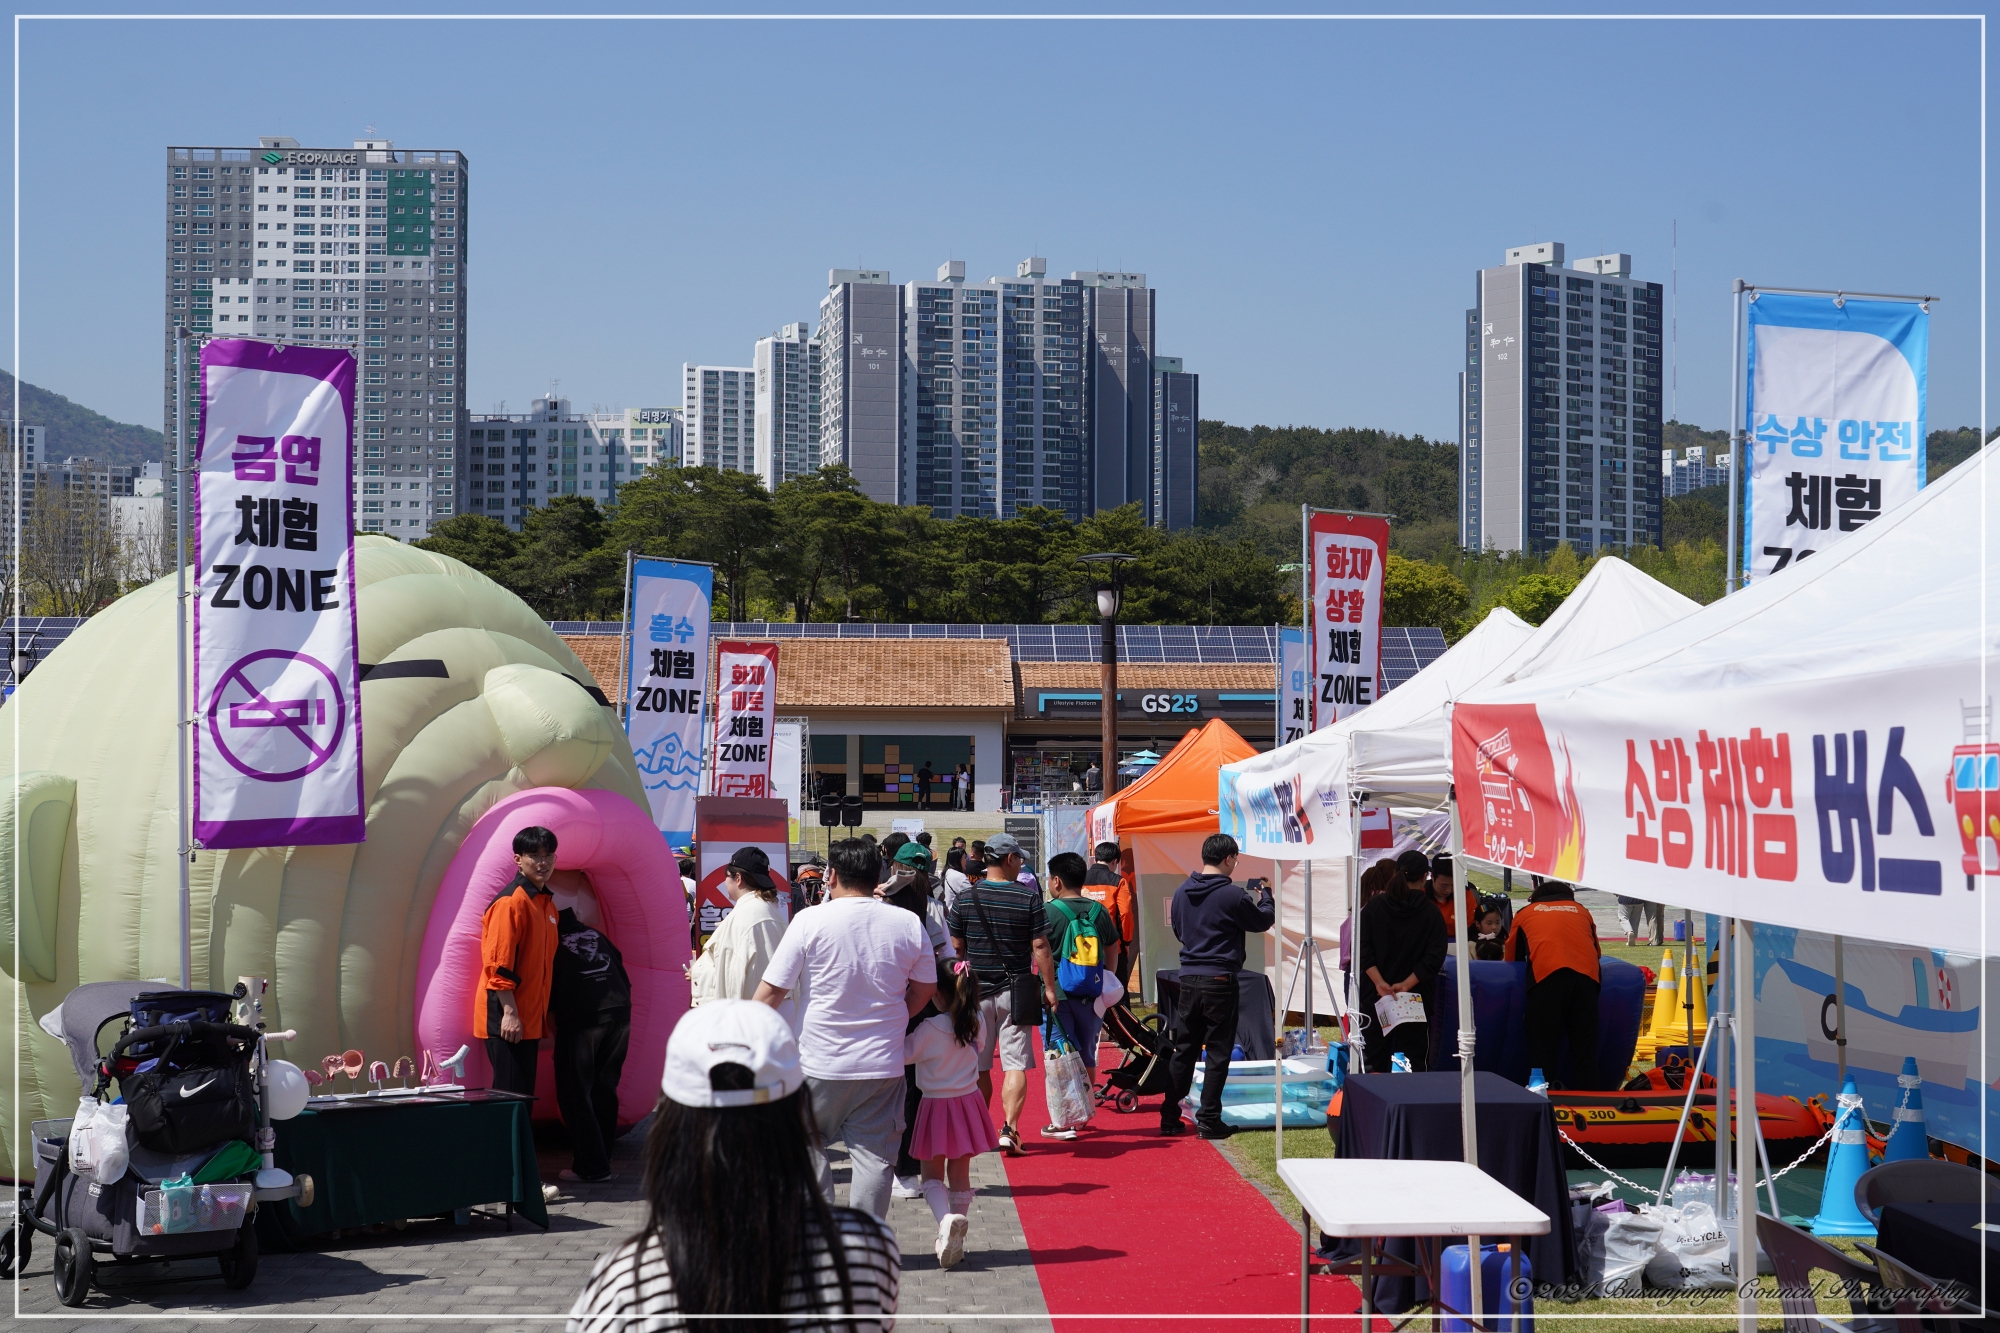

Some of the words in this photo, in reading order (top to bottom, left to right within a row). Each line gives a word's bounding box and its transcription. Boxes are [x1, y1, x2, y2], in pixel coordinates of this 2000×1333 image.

[1497, 352, 1508, 360] 102
[1755, 414, 1828, 458] 수상
[1838, 419, 1912, 462] 안전
[231, 434, 322, 486] 금연
[1785, 471, 1882, 532] 체험
[234, 495, 319, 552] 체험
[1326, 544, 1373, 581] 화재
[210, 564, 340, 612] ZONE
[1326, 588, 1365, 624] 상황
[649, 612, 695, 645] 홍수
[1328, 628, 1362, 665] 체험
[649, 647, 695, 680] 체험
[731, 663, 765, 686] 화재
[635, 686, 700, 715] ZONE
[731, 691, 764, 712] 미로
[1141, 694, 1199, 713] GS25
[1320, 674, 1372, 705] ZONE
[729, 715, 763, 738] 체험
[719, 743, 768, 762] ZONE
[1625, 728, 1798, 882] 소방체험
[1812, 726, 1942, 896] 버스
[1588, 1110, 1616, 1120] 300
